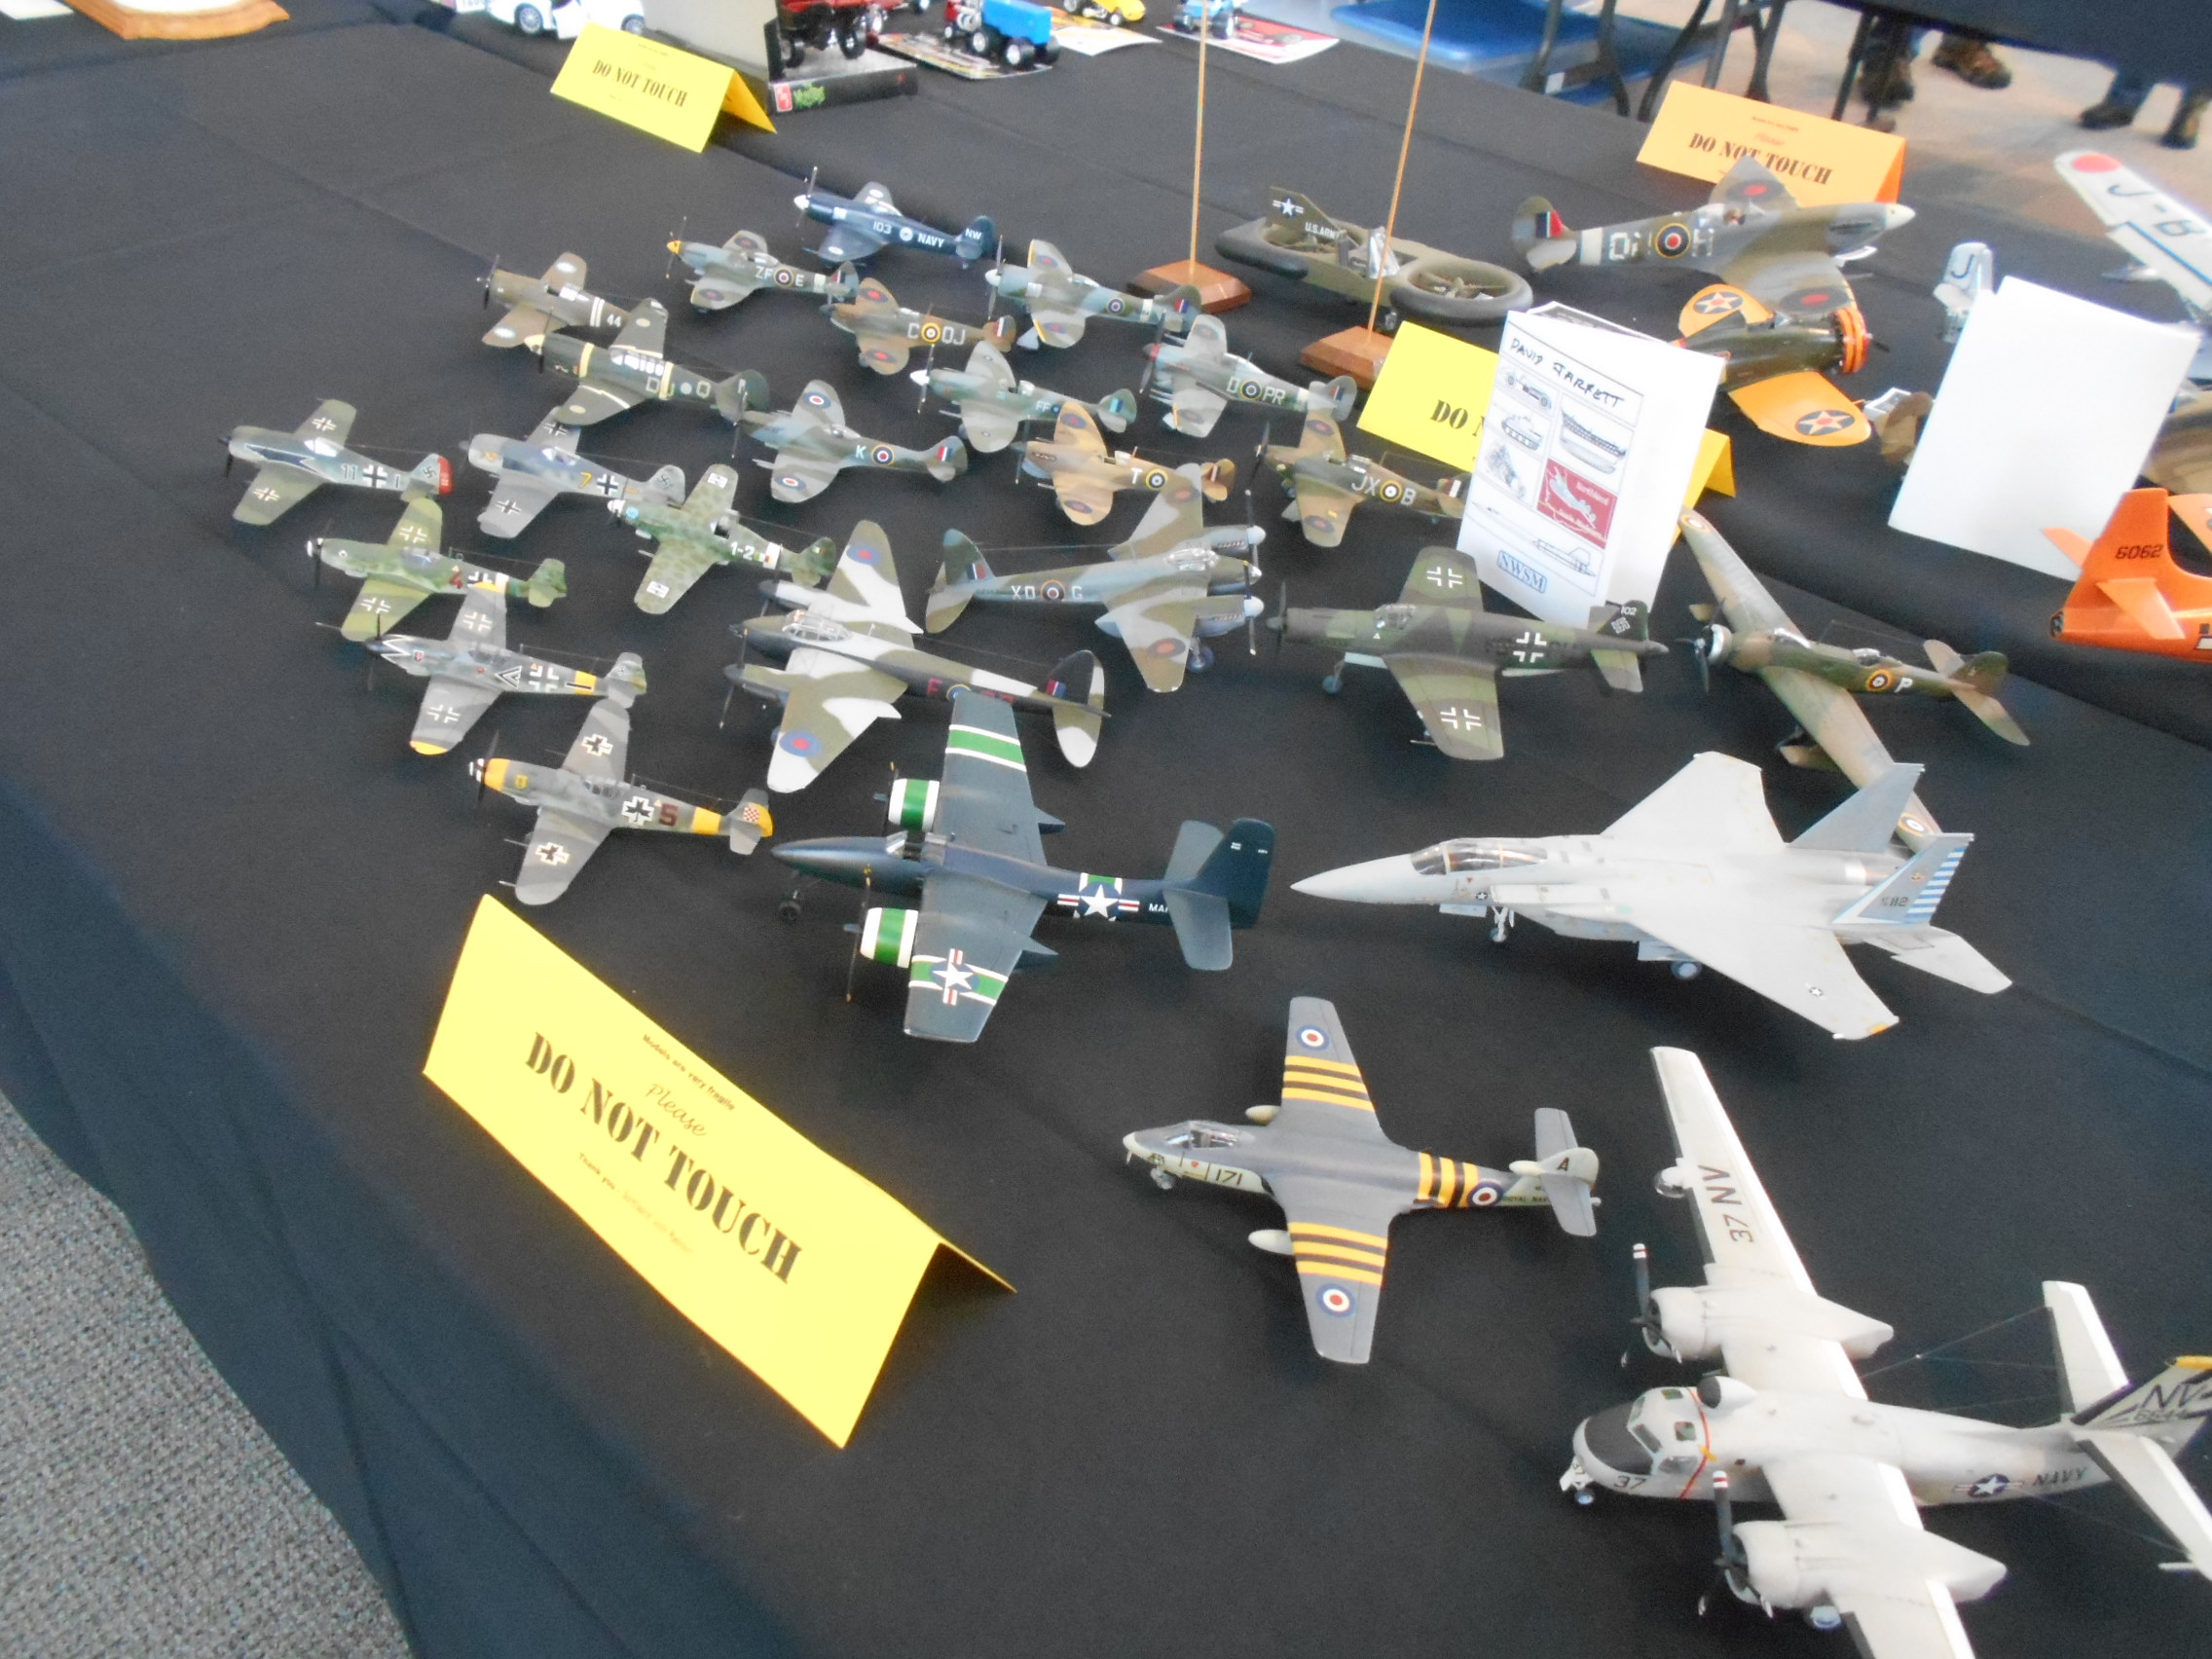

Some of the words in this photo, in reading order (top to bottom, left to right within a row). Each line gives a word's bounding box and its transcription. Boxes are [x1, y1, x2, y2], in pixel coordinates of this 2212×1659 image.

[592, 59, 612, 77] DO
[613, 67, 642, 89] NOT
[643, 78, 688, 107] TOUCH
[1689, 132, 1716, 152] DO
[1764, 152, 1833, 185] TOUCH
[872, 221, 892, 235] 103
[965, 228, 982, 240] NW
[917, 233, 945, 248] NAVY
[755, 265, 774, 279] ZF
[794, 273, 804, 287] E
[607, 313, 622, 328] 44
[1510, 338, 1544, 365] DAVID
[1553, 361, 1626, 408] JARRETT
[1262, 386, 1286, 406] PR
[1429, 399, 1469, 430] DO
[856, 445, 867, 460] K
[580, 472, 593, 489] 7
[1130, 467, 1144, 485] T
[1351, 476, 1382, 498] JX
[1400, 487, 1418, 506] B
[730, 541, 756, 561] 1-2
[2115, 544, 2164, 560] 6062
[1500, 551, 1545, 591] NWSM
[1071, 584, 1084, 600] G
[1620, 606, 1638, 616] 102
[1893, 676, 1914, 694] P
[658, 802, 680, 827] 5
[643, 1033, 672, 1061] Models
[671, 1058, 686, 1073] are
[687, 1071, 708, 1089] very
[707, 1085, 736, 1112] fragile
[645, 1083, 708, 1137] Please
[525, 1031, 576, 1094] DO
[579, 1077, 661, 1162] NOT
[663, 1144, 803, 1285] TOUCH
[1556, 1157, 1569, 1172] A
[579, 1151, 602, 1176] Thank
[601, 1176, 616, 1191] you
[1215, 1168, 1243, 1186] 171
[1613, 1474, 1647, 1490] 37
[2031, 1466, 2088, 1487] NAVY
